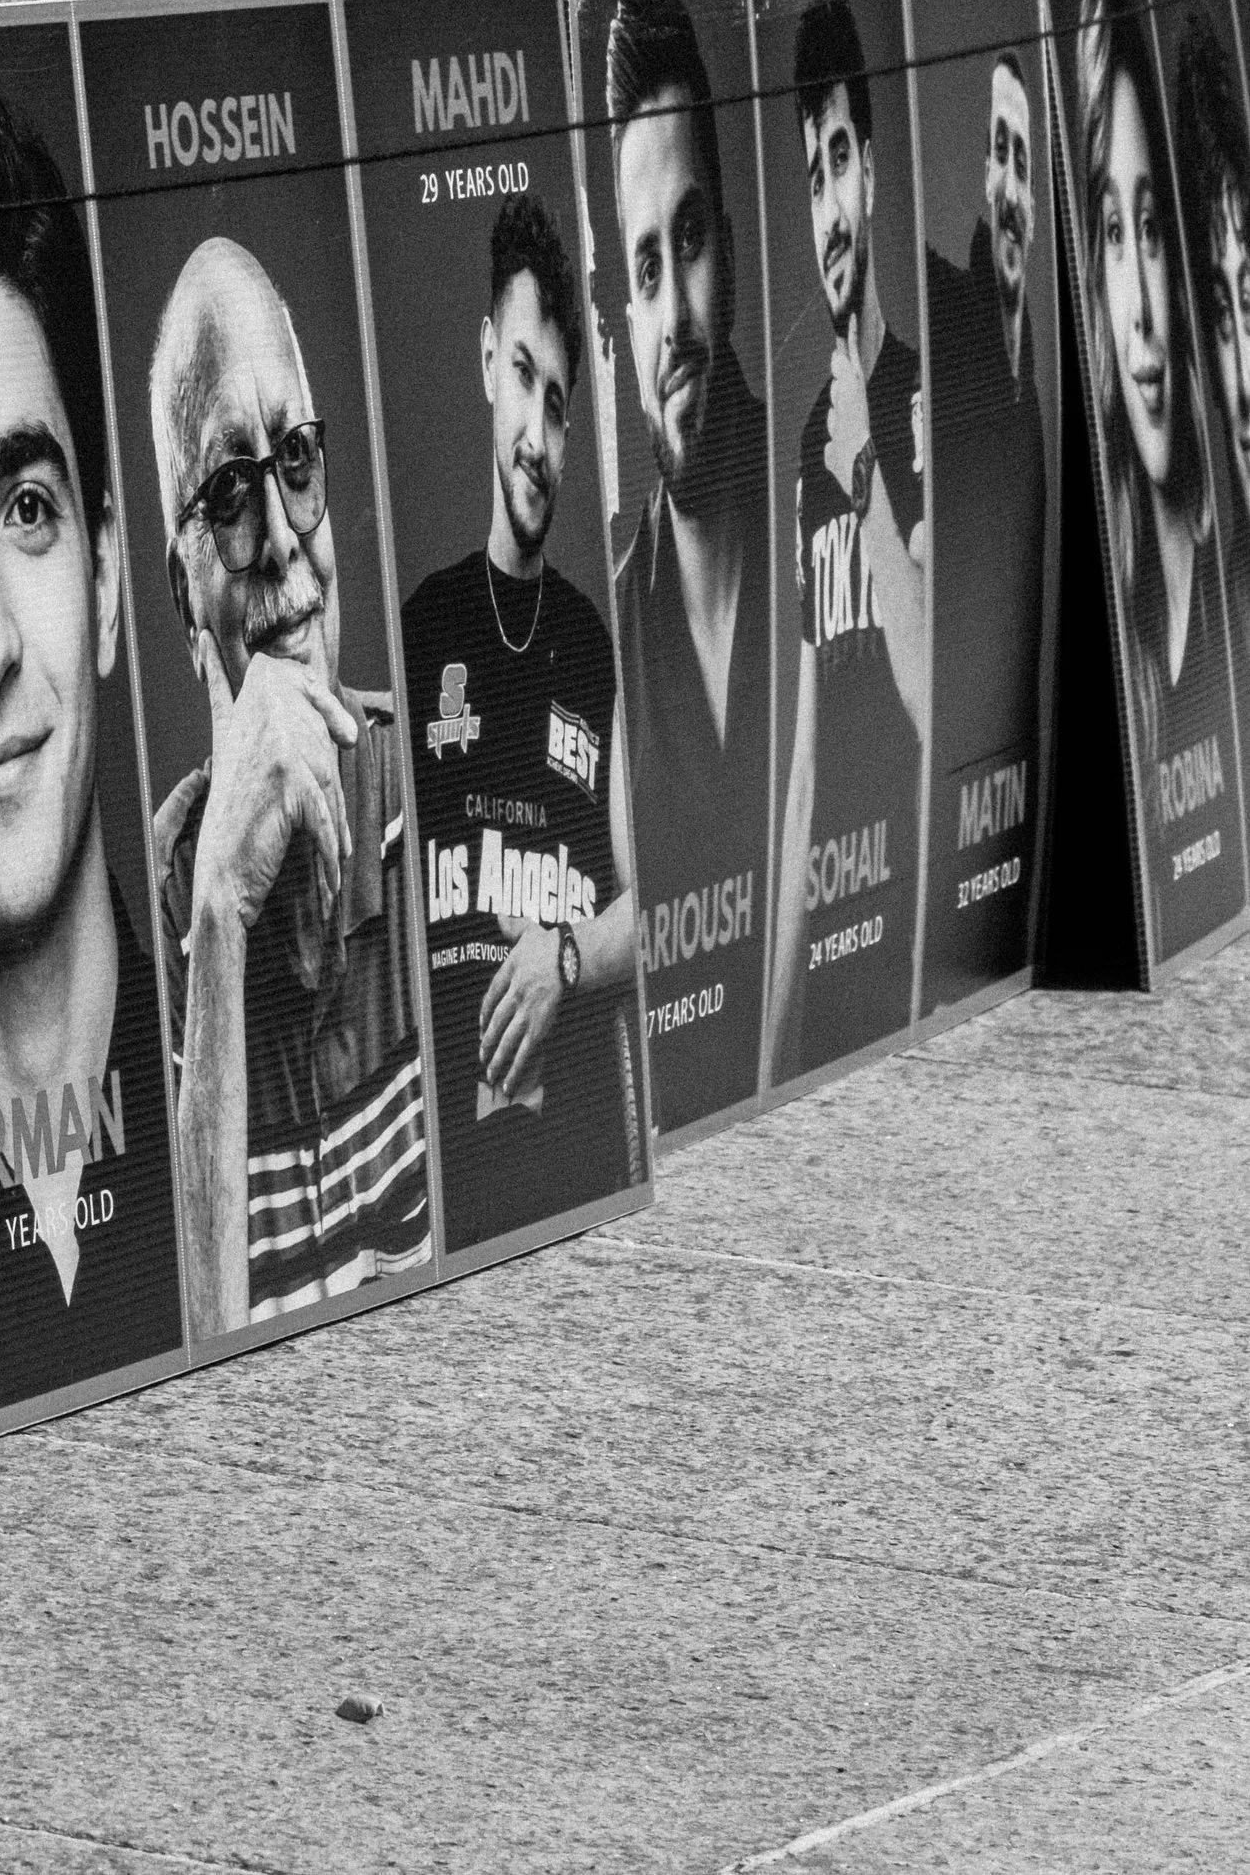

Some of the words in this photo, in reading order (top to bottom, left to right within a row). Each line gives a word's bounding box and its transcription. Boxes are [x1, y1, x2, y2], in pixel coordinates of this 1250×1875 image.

[411, 49, 530, 133] MAHDI
[145, 92, 296, 169] HOSSEIN
[420, 173, 438, 203] 29
[445, 166, 495, 200] YEARS
[498, 162, 529, 194] OLD
[548, 712, 600, 791] BEST
[1159, 735, 1225, 825] ROBINA
[466, 793, 547, 828] CALIFORNIA
[958, 760, 1026, 850] MATIN
[428, 838, 469, 923] Los
[477, 828, 596, 926] Angeles
[804, 819, 891, 911] SOHAIL
[1205, 830, 1221, 861] OLD
[957, 881, 969, 908] 32
[970, 866, 1000, 902] YEARS
[1001, 857, 1020, 889] OLD
[808, 940, 822, 970] 24
[824, 924, 859, 963] YEARS
[860, 915, 883, 948] OLD
[647, 1010, 656, 1038] 7
[657, 993, 696, 1034] YEARS
[698, 983, 724, 1017] OLD
[74, 1189, 114, 1230] OLD
